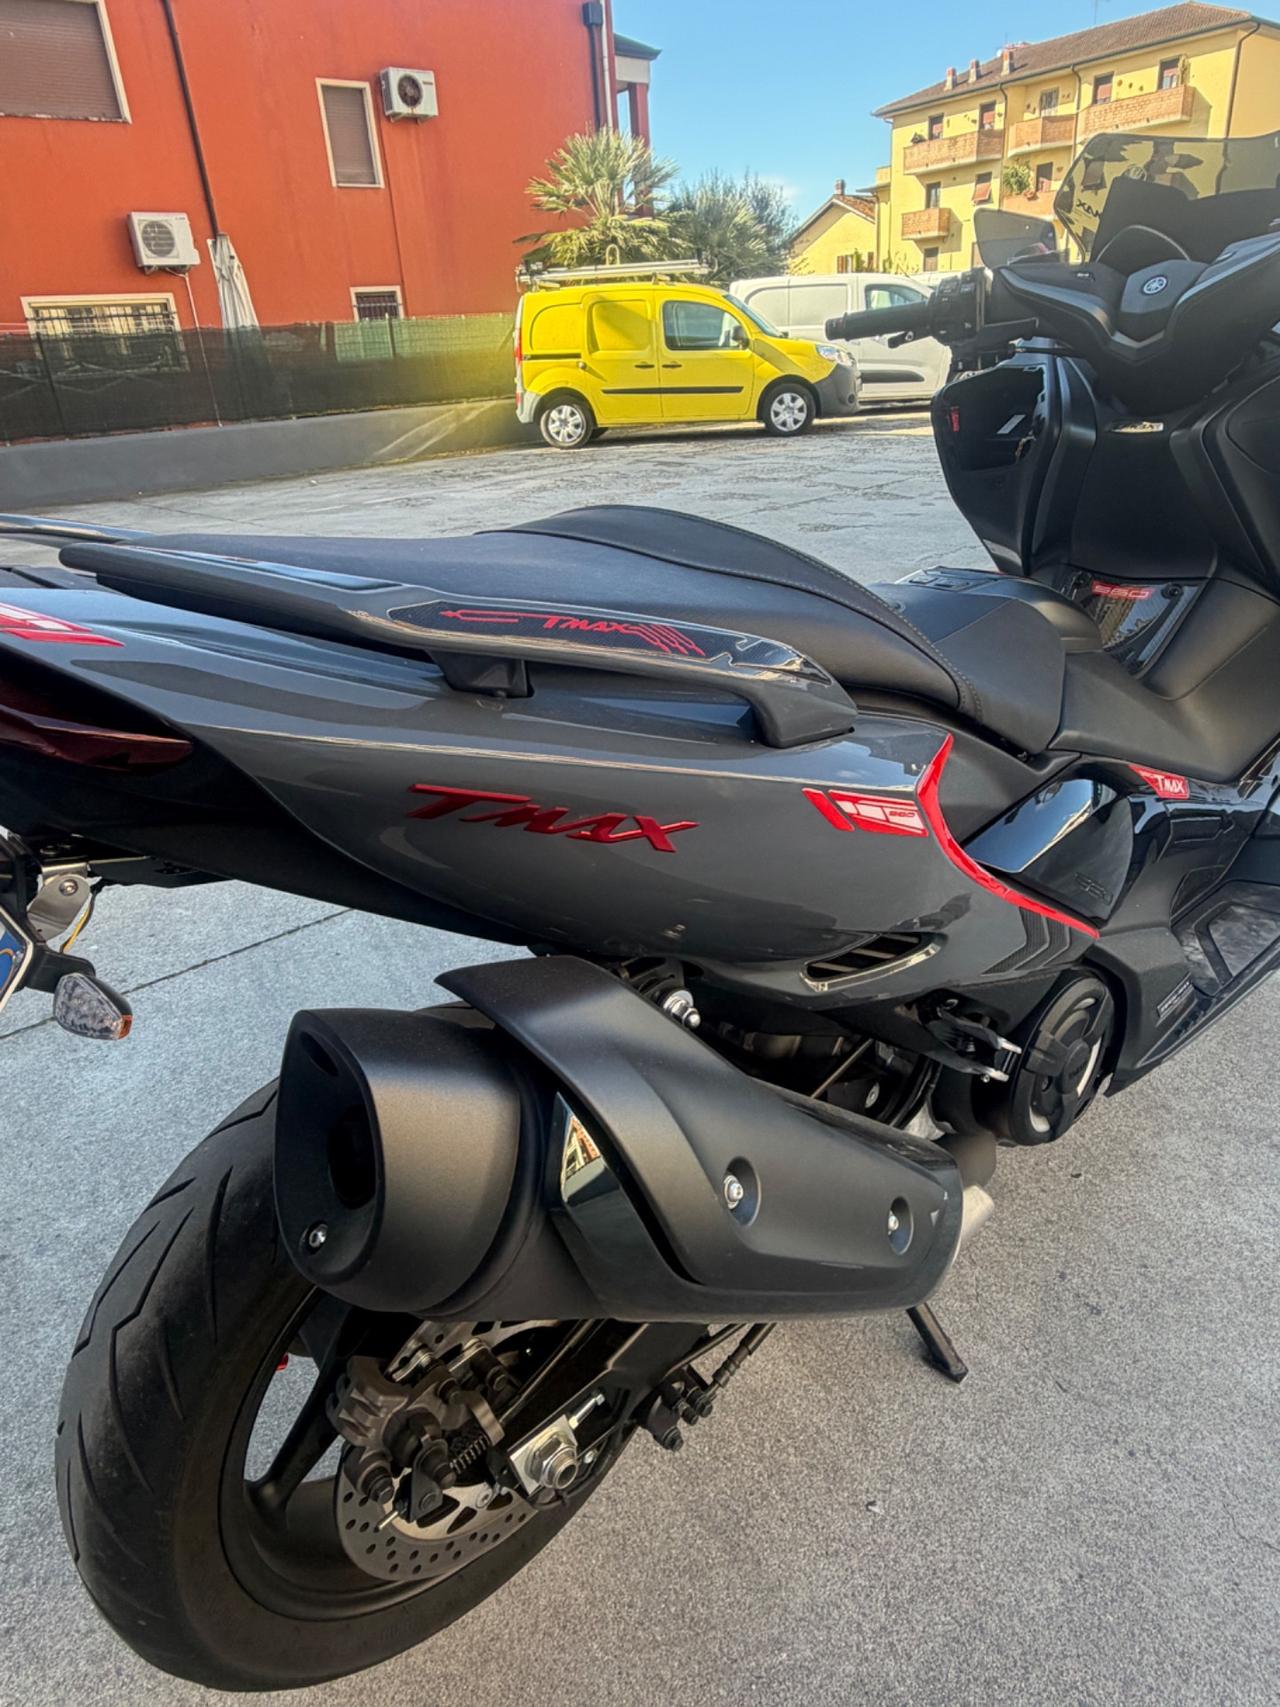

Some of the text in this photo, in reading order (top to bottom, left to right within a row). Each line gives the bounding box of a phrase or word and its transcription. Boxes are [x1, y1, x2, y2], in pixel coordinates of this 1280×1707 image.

[543, 615, 628, 633] TMAX
[1153, 774, 1185, 794] TMAX
[405, 783, 699, 853] TMAX
